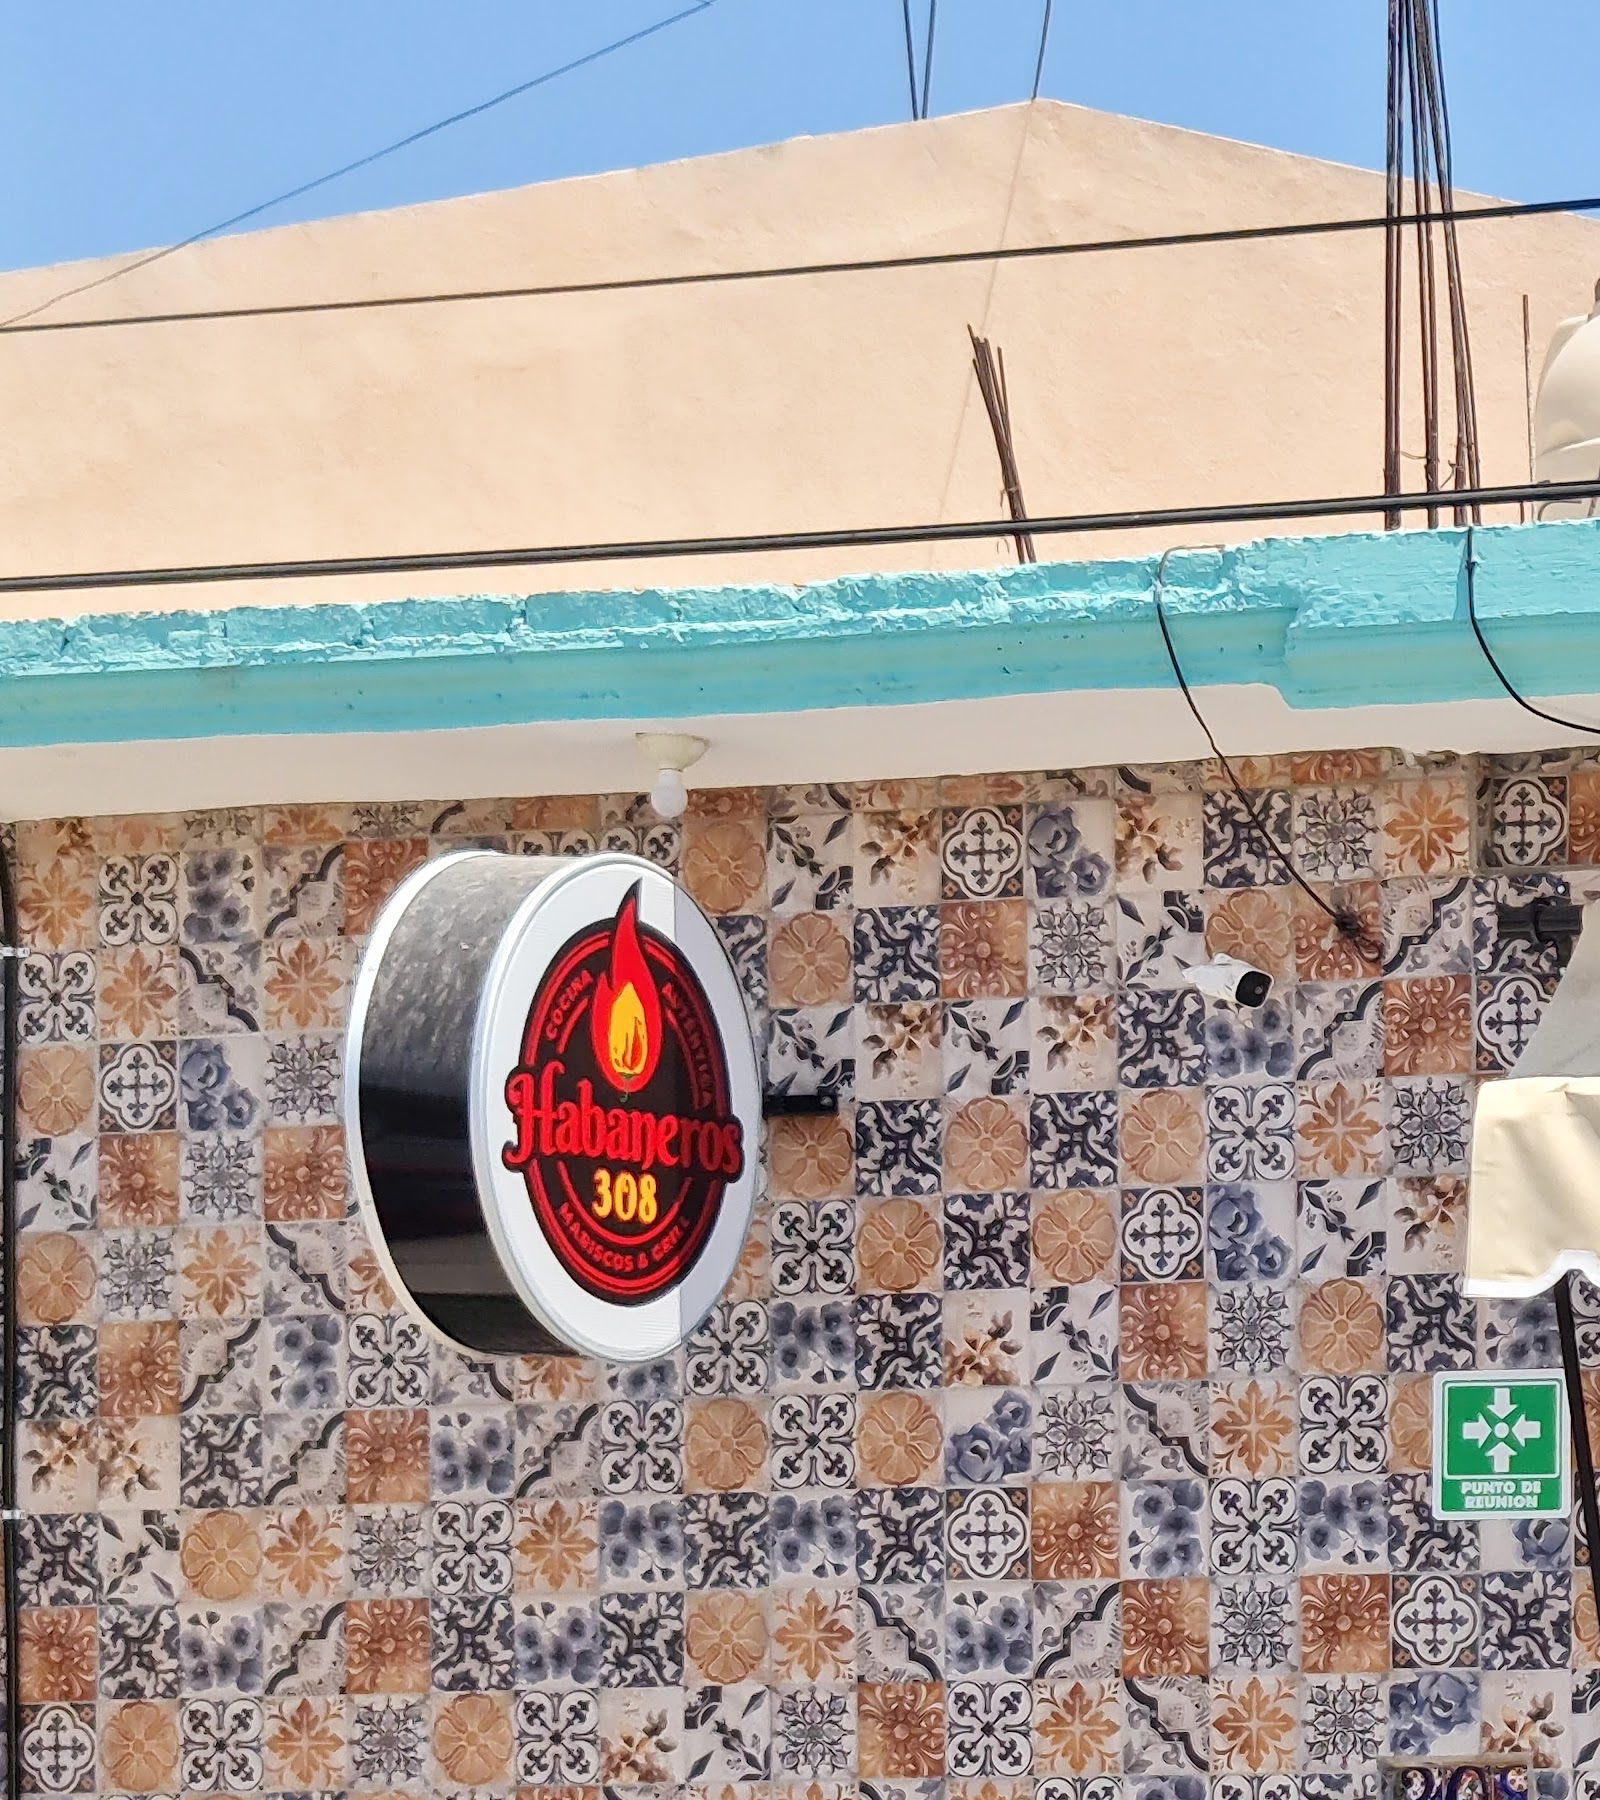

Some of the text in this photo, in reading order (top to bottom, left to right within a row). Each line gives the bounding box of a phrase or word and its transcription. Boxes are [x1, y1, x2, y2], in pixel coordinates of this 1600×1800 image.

[505, 1060, 740, 1174] Habaneros
[592, 1168, 658, 1225] 308
[1461, 1481, 1541, 1495] PUNTO DE
